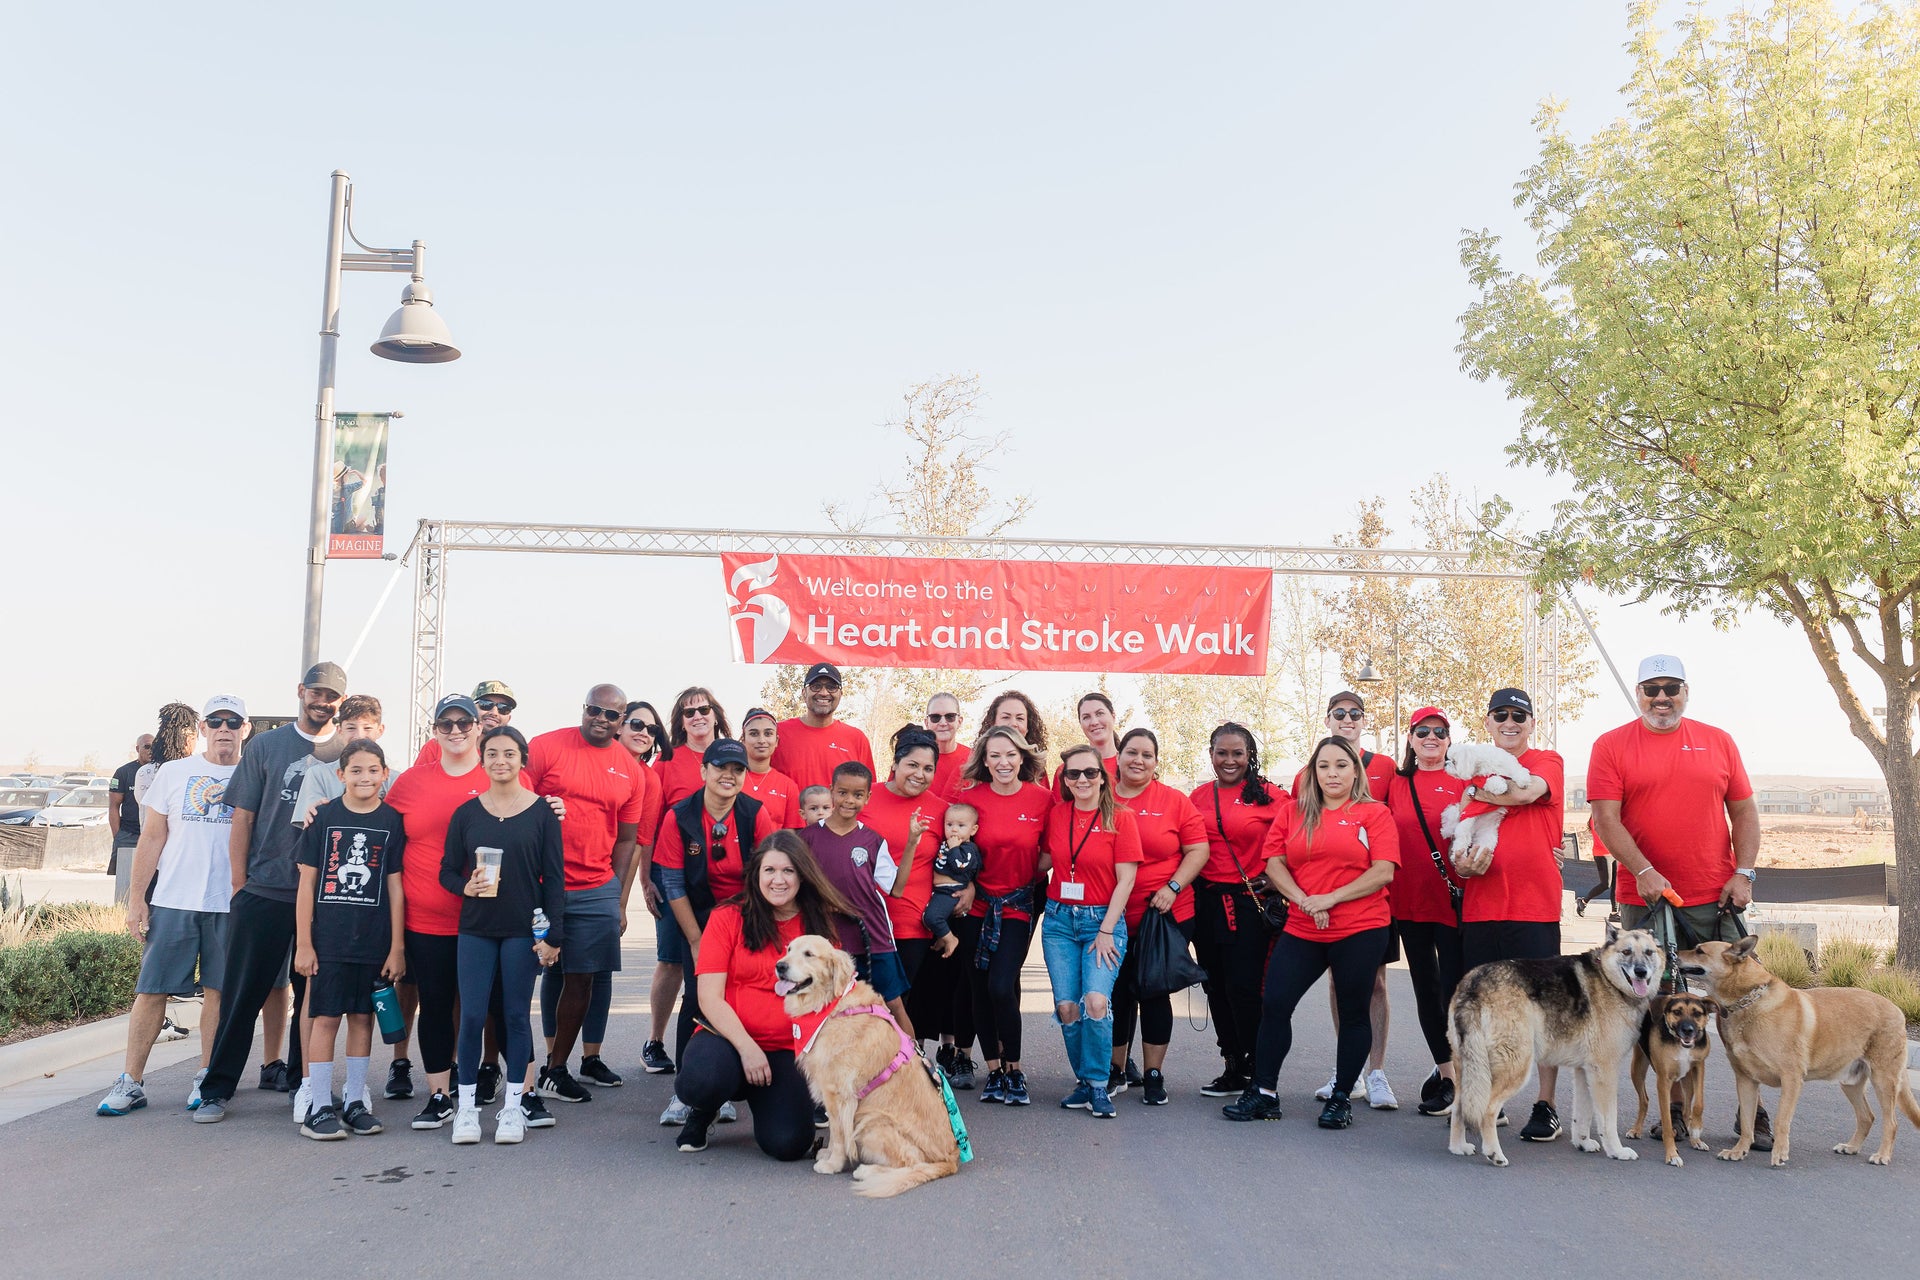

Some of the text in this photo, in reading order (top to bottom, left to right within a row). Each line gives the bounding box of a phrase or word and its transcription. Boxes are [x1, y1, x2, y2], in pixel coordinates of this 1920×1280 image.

[331, 540, 382, 551] IMAGINE
[807, 577, 994, 601] Welcome to the
[808, 614, 1255, 657] Heart and Stroke Walk
[203, 817, 233, 825] TELEVISI
